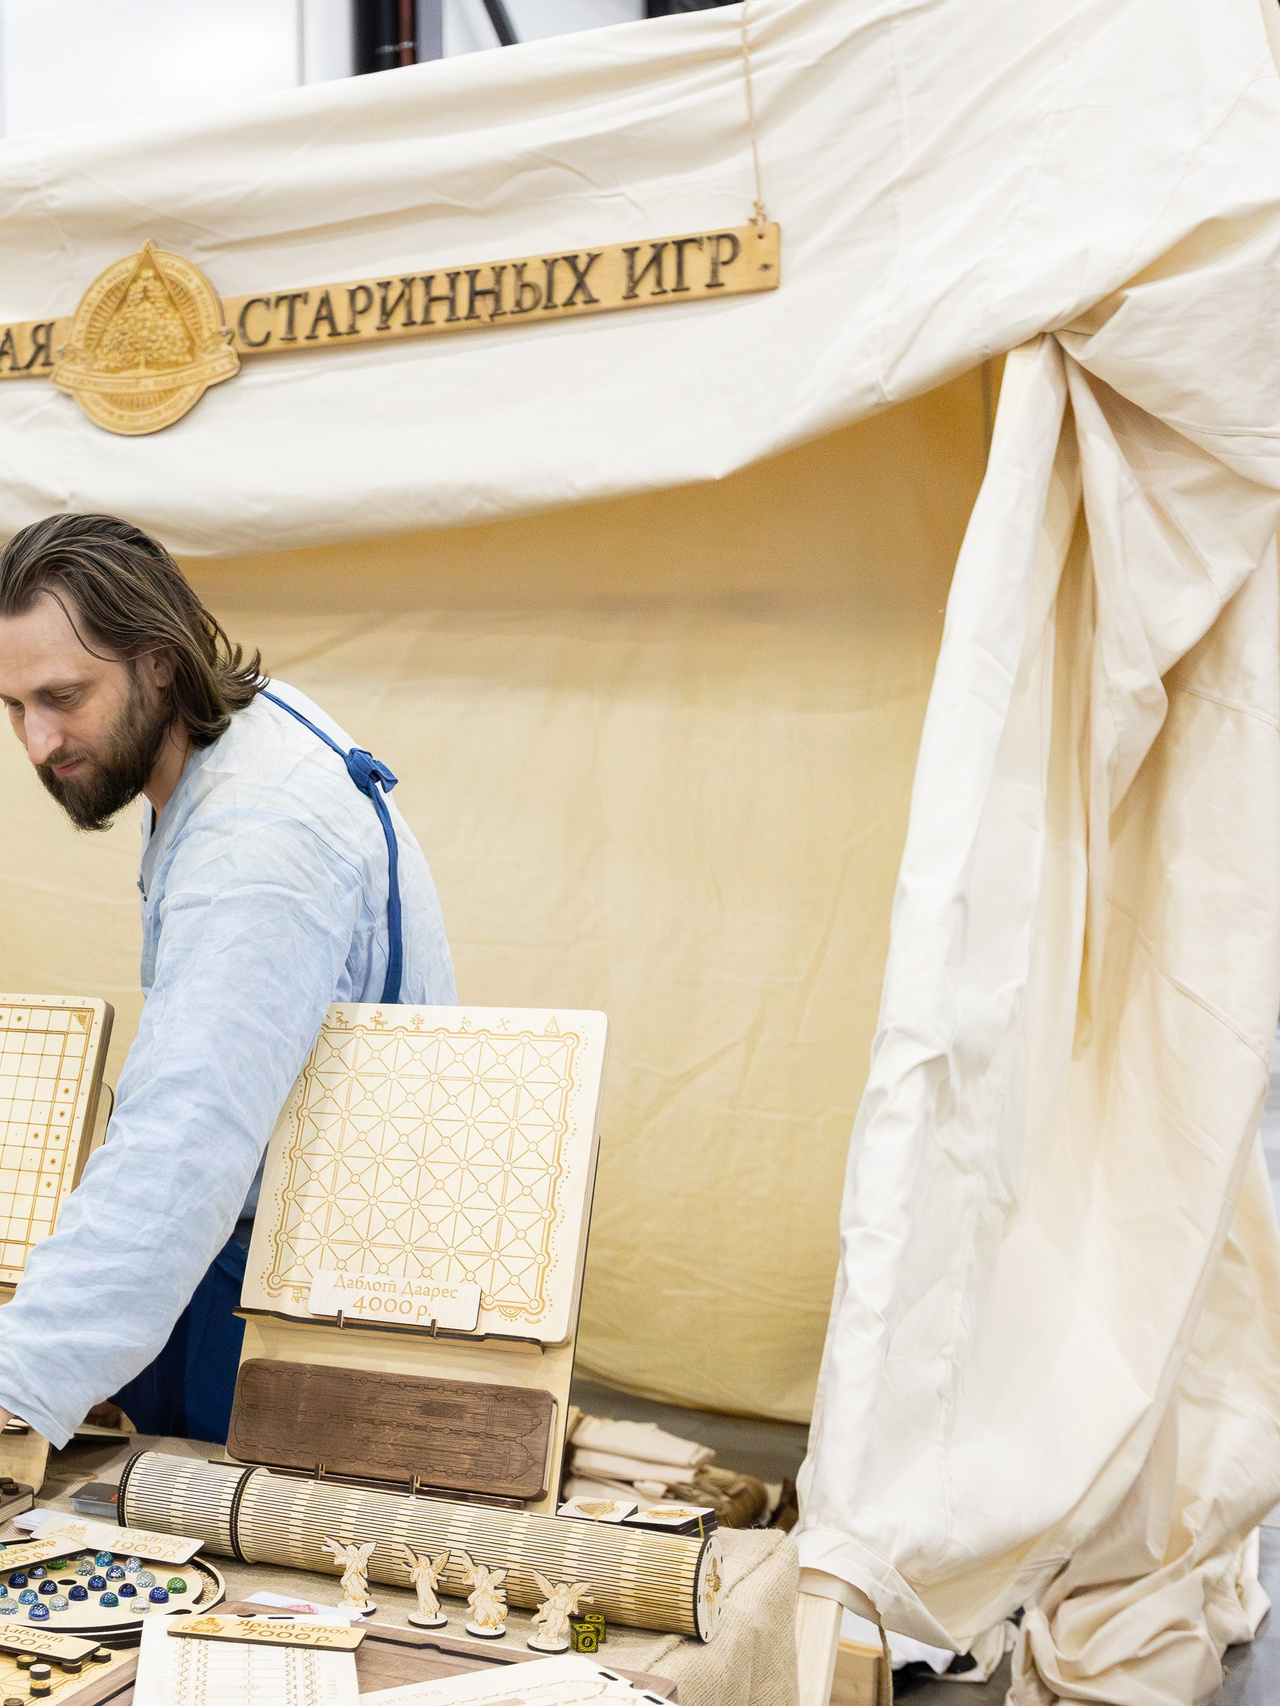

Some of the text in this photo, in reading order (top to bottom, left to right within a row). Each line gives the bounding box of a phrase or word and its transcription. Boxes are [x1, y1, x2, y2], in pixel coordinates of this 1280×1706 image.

[237, 252, 602, 348] СТАРИННЫХ
[620, 232, 743, 300] ИГР
[333, 1274, 458, 1302] Даблот Даарес
[352, 1295, 413, 1315] 4000
[29, 1540, 57, 1550] игр
[109, 1540, 162, 1555] 1900
[120, 1530, 191, 1550] Солитер
[235, 1620, 350, 1635] Ярлов стол
[241, 1628, 312, 1640] 7000
